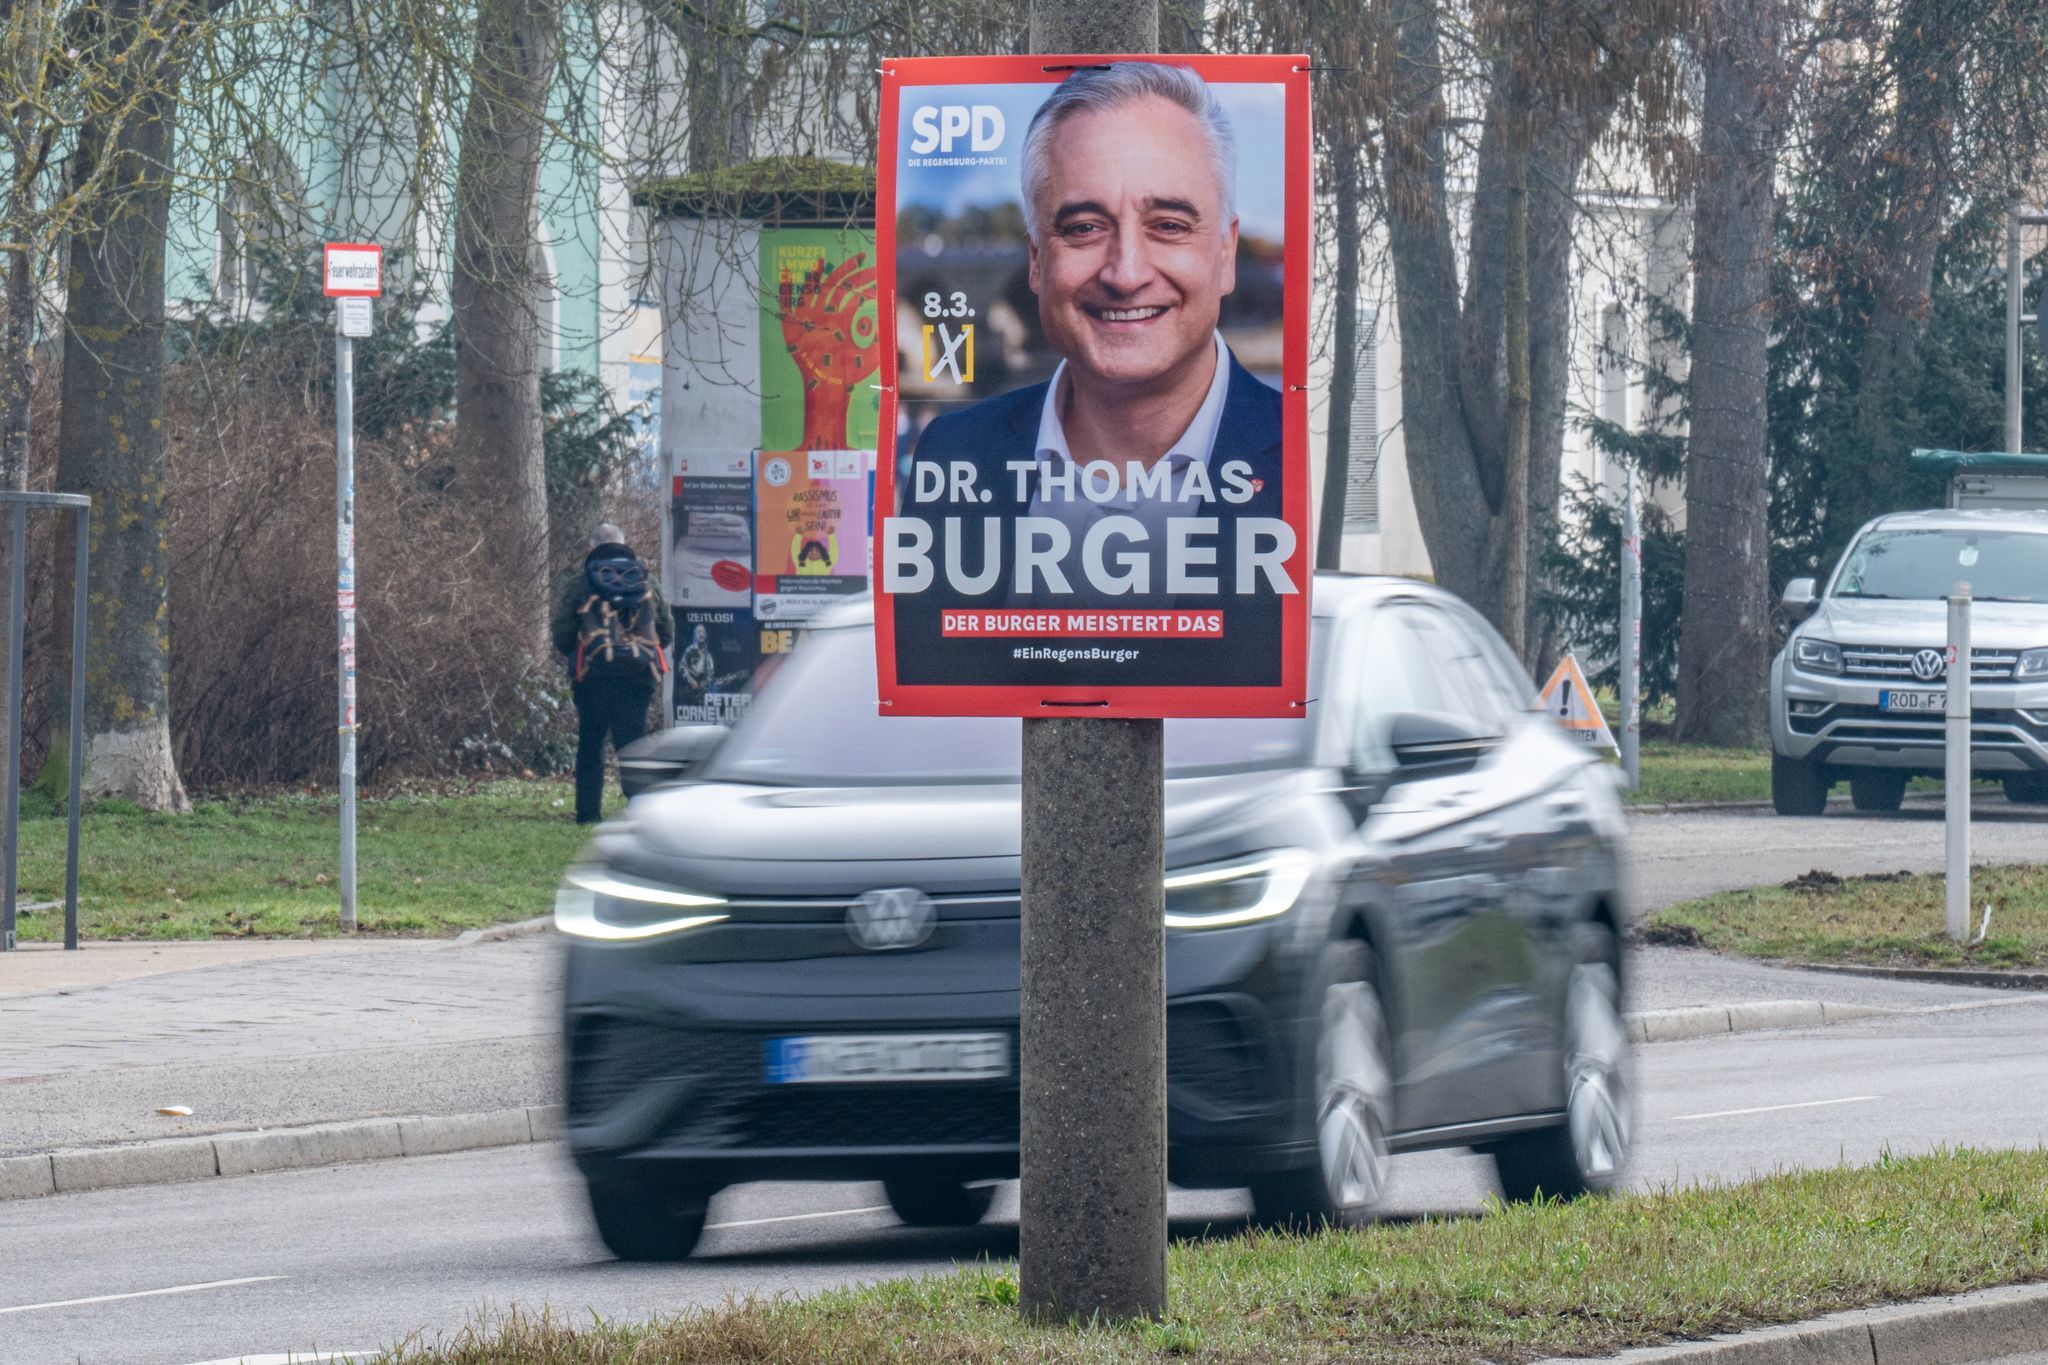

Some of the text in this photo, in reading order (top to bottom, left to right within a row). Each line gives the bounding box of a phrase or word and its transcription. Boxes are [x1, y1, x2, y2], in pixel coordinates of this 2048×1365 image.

[910, 105, 1005, 155] SPD
[908, 157, 1007, 167] DIE REGENSBURG-PARTEI
[924, 291, 976, 318] 8.3.
[915, 460, 1254, 503] DR. THOMAS
[793, 489, 837, 502] RASSISMUS
[883, 515, 1300, 595] BURGER
[944, 615, 1220, 632] DER BURGER MEISTERT DAS
[1013, 648, 1139, 662] #EinRegensBurger
[1889, 693, 1918, 708] ROD
[1927, 694, 1937, 708] F
